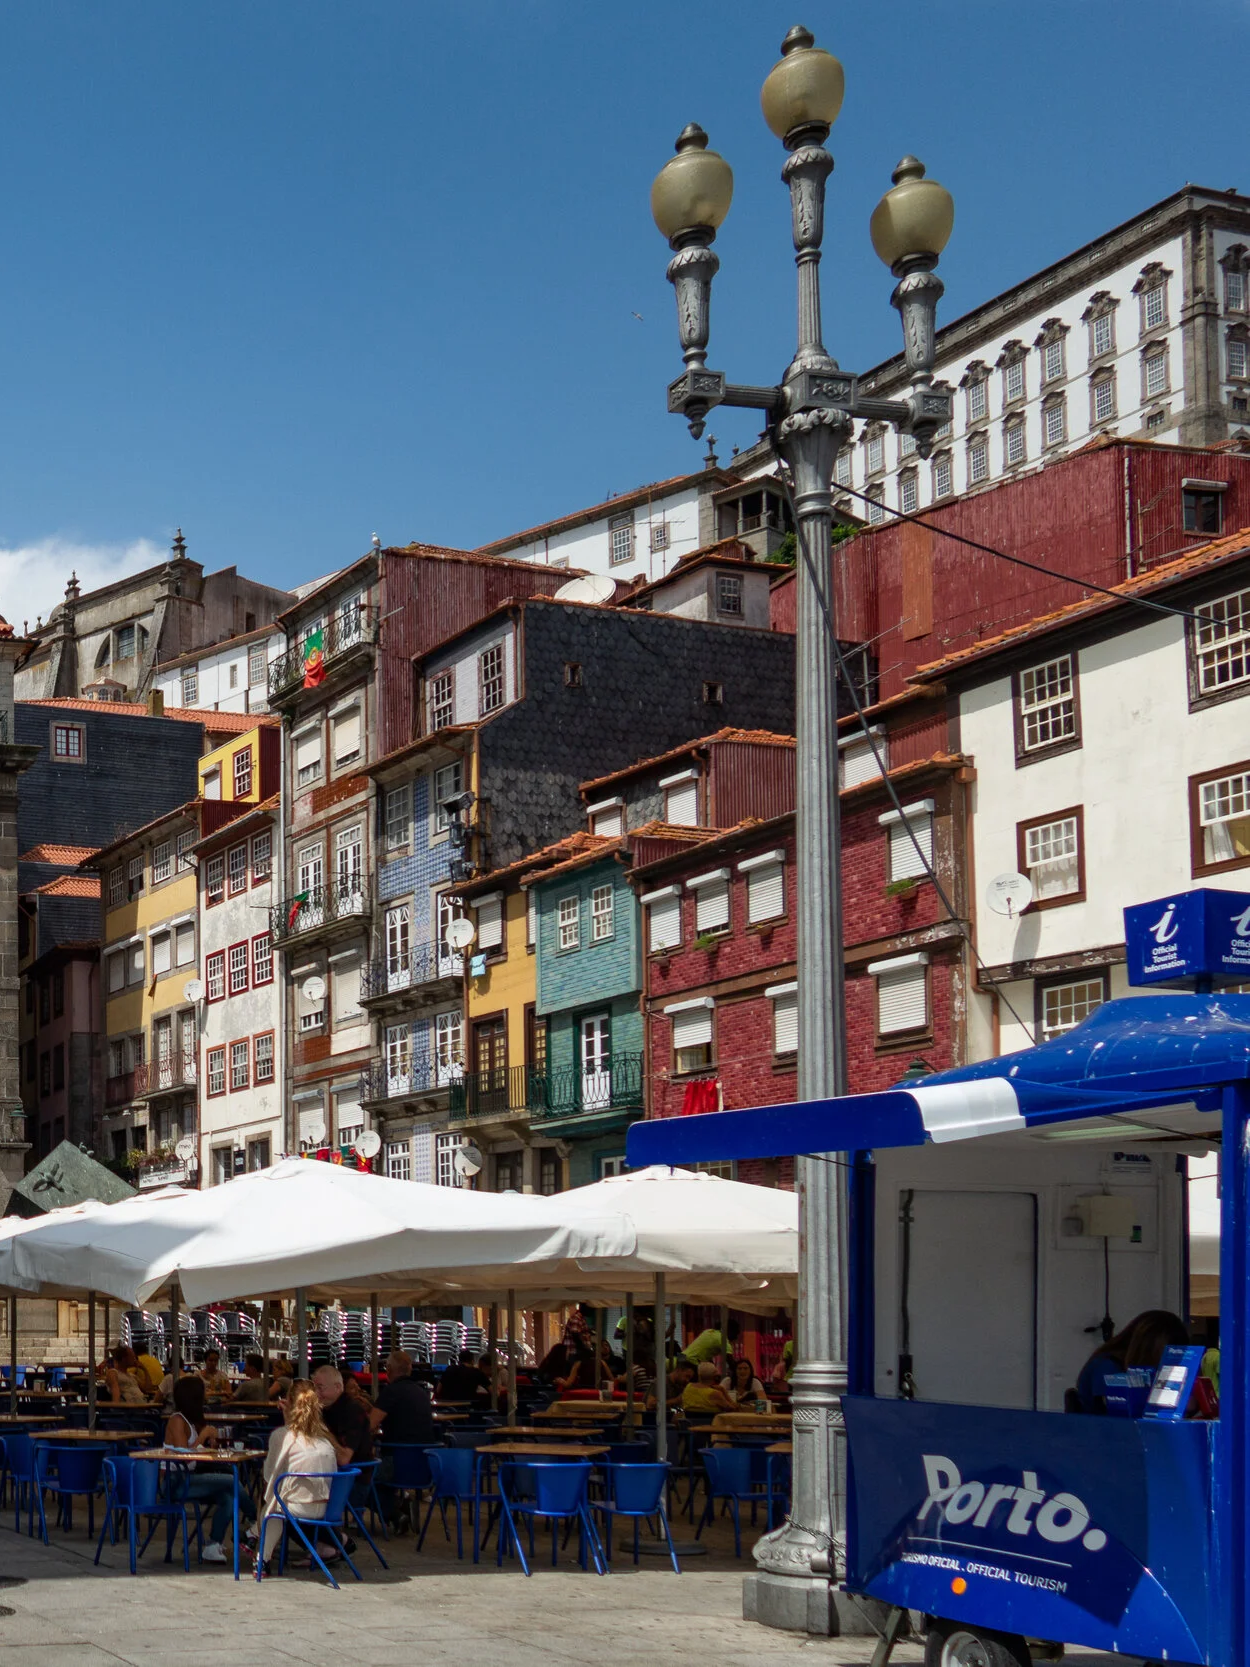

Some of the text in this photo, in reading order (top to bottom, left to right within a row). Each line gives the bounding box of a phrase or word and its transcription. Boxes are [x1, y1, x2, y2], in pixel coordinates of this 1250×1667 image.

[1152, 943, 1178, 955] Official
[1152, 952, 1178, 963] Tourist
[1144, 960, 1186, 973] Information
[916, 1454, 1107, 1551] Porto.
[928, 1555, 960, 1571] OFICIAL
[966, 1562, 1012, 1581] OFFICIAL
[1014, 1571, 1068, 1593] TOURISM
